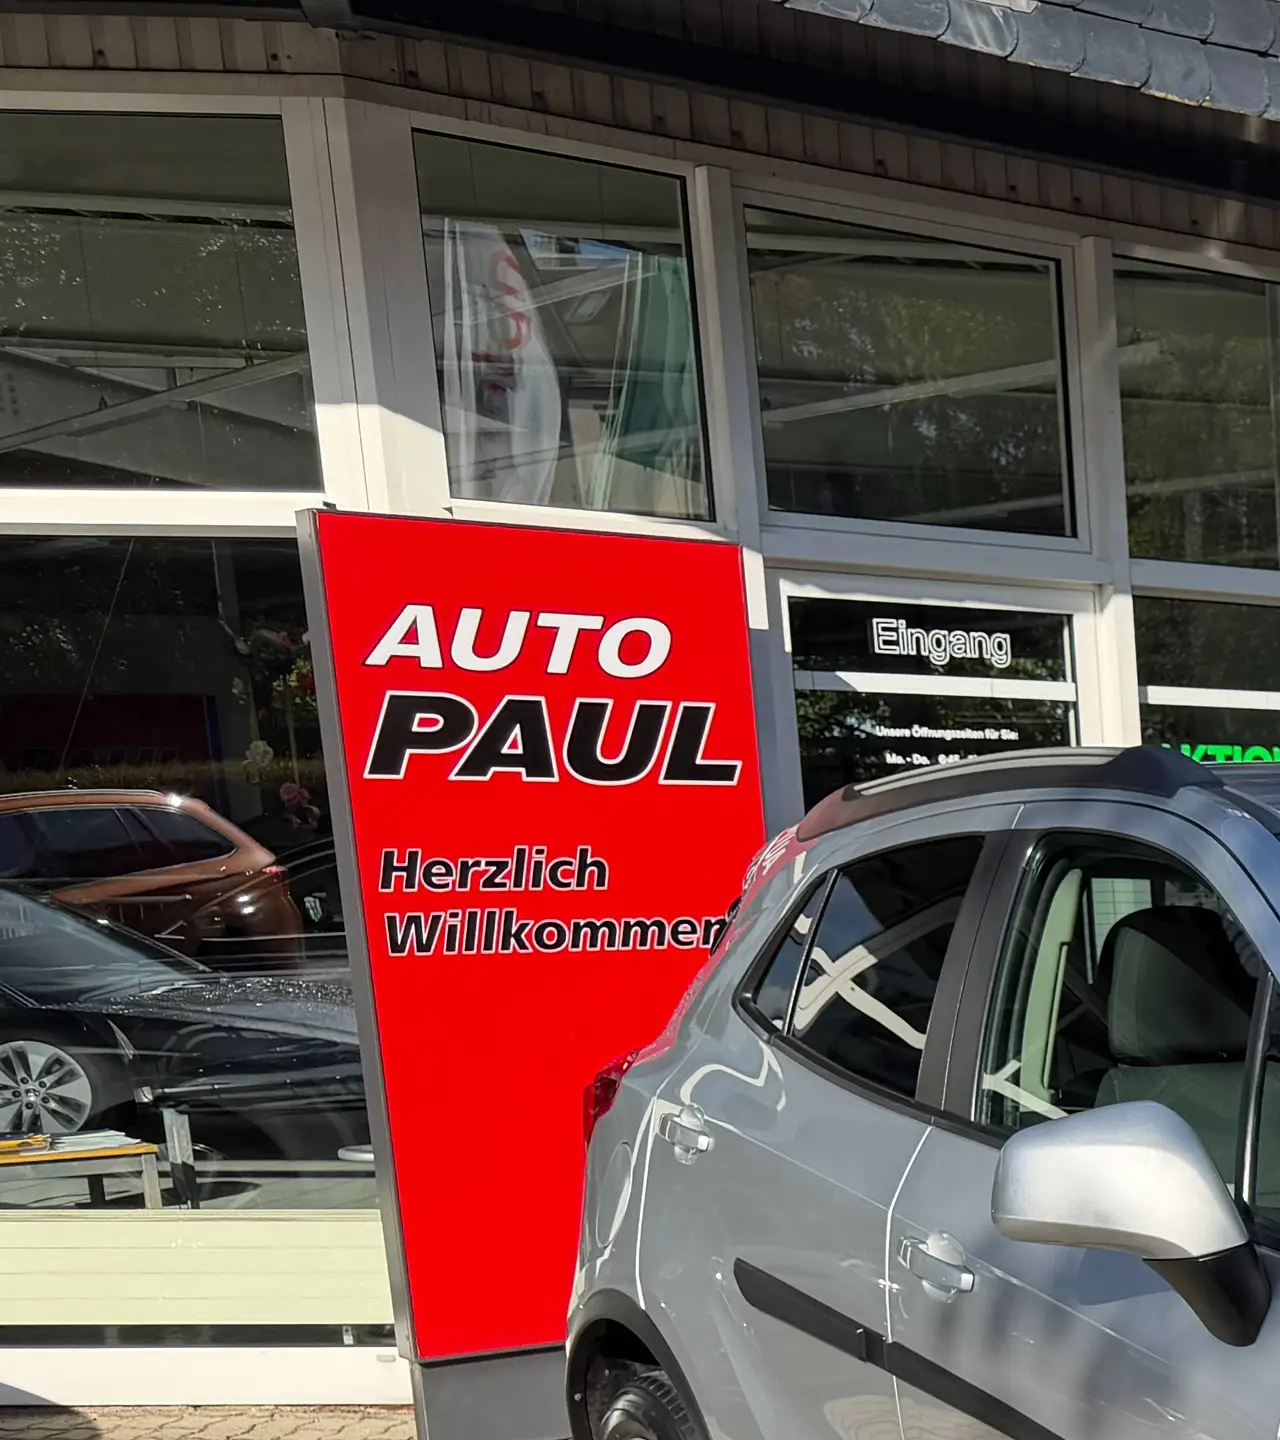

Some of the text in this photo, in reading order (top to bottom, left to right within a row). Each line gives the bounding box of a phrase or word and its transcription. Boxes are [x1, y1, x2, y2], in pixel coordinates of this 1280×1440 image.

[363, 604, 672, 679] AUTO
[872, 617, 1011, 669] Eingang
[364, 690, 743, 786] PAUL
[875, 725, 911, 738] Unsere
[912, 723, 984, 741] Öffnungszeiten
[985, 727, 999, 740] für
[379, 845, 609, 894] Herzlich
